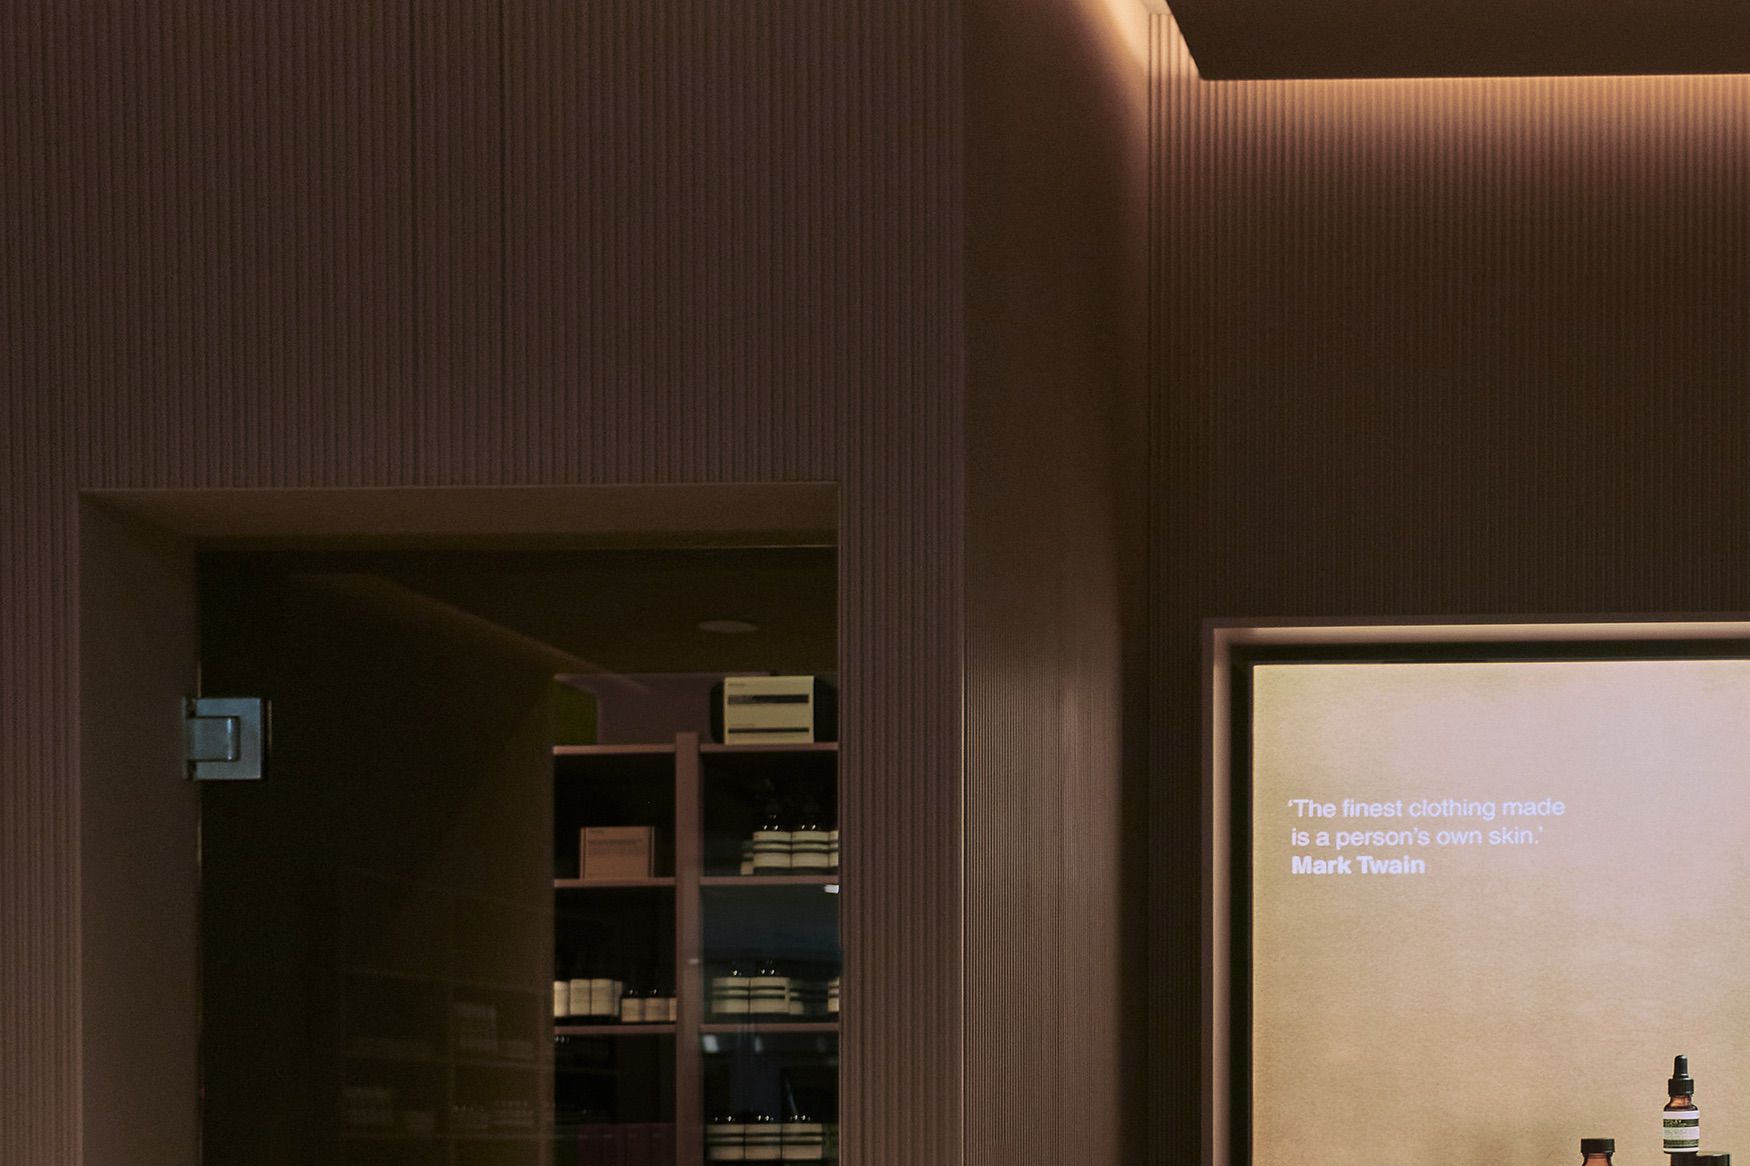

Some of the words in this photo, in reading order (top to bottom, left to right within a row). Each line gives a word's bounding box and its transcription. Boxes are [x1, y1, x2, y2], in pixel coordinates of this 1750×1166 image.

[1342, 798, 1403, 819] finest
[1408, 798, 1497, 822] clothing
[1503, 798, 1566, 818] made
[1291, 828, 1311, 847] is
[1316, 832, 1331, 847] a
[1437, 831, 1483, 846] own
[1291, 855, 1353, 876] Mark
[1357, 854, 1427, 876] Twain
